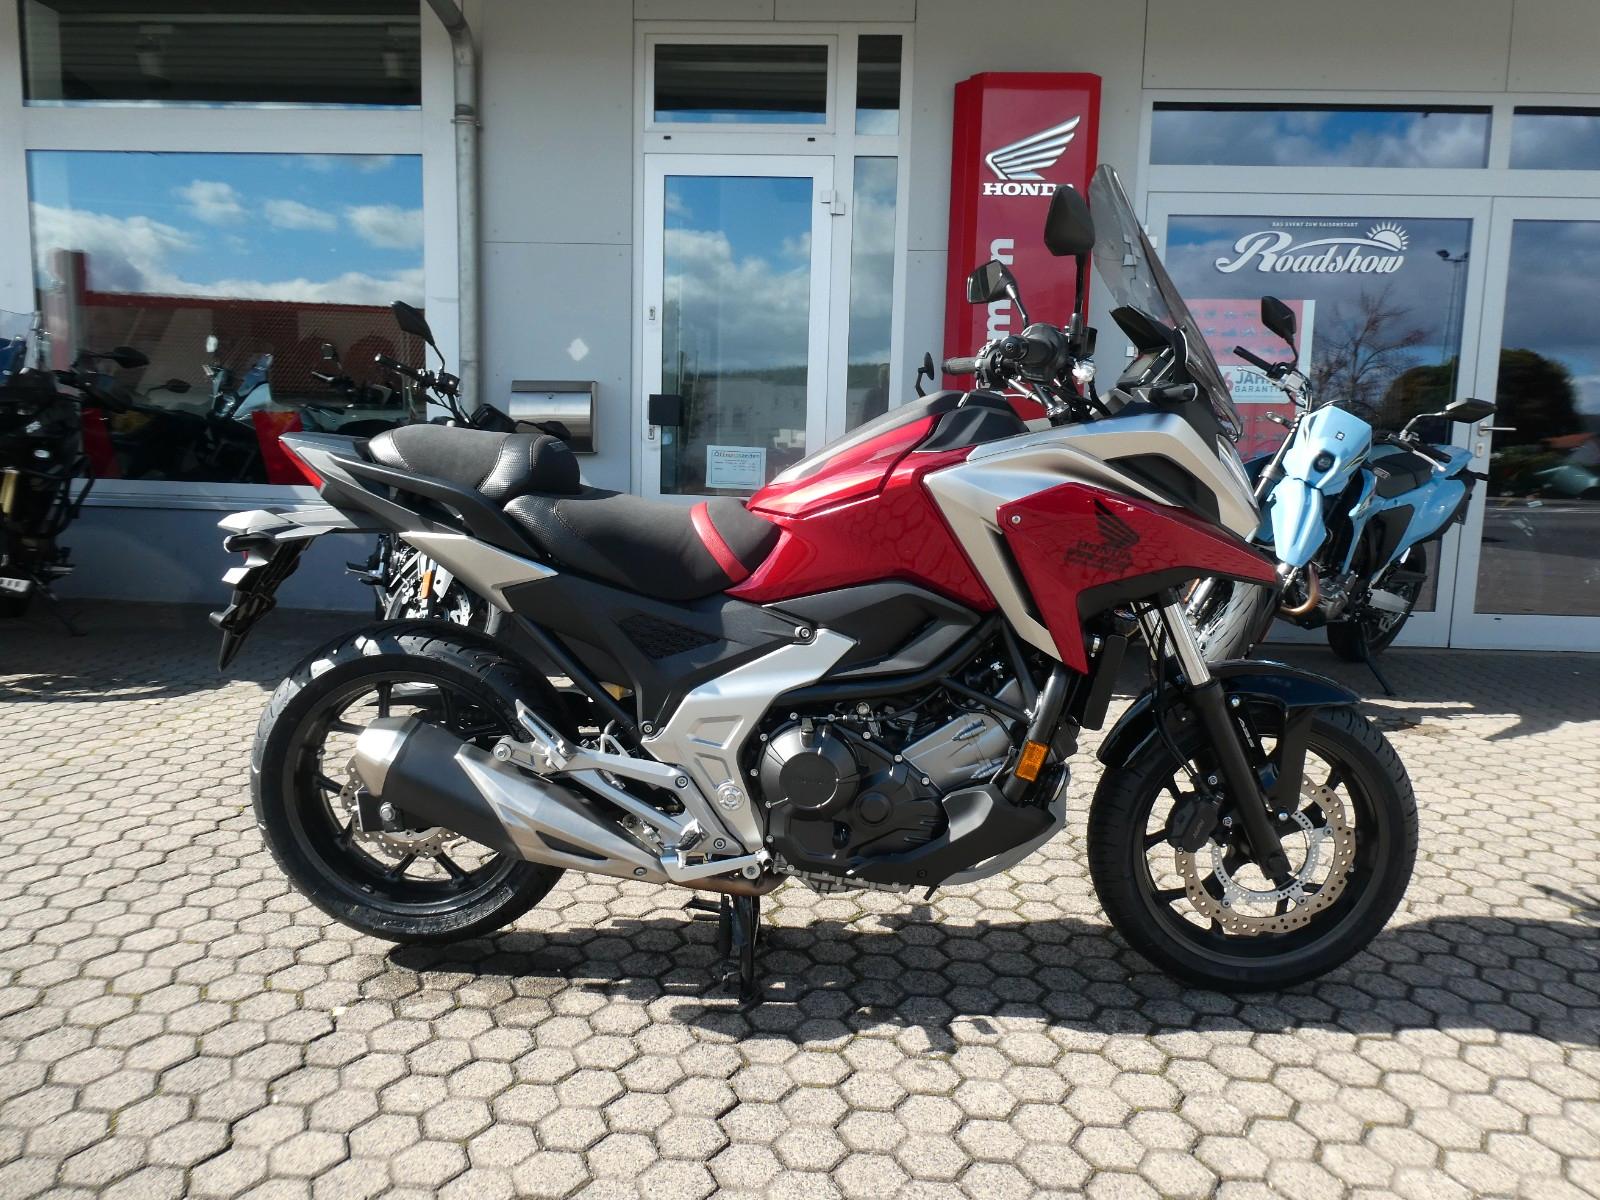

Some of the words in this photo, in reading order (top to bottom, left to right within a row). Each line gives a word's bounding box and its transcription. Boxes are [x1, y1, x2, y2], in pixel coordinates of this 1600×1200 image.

[983, 182, 1074, 196] HOND
[1215, 231, 1405, 273] Roadshow
[1235, 371, 1272, 385] JAH
